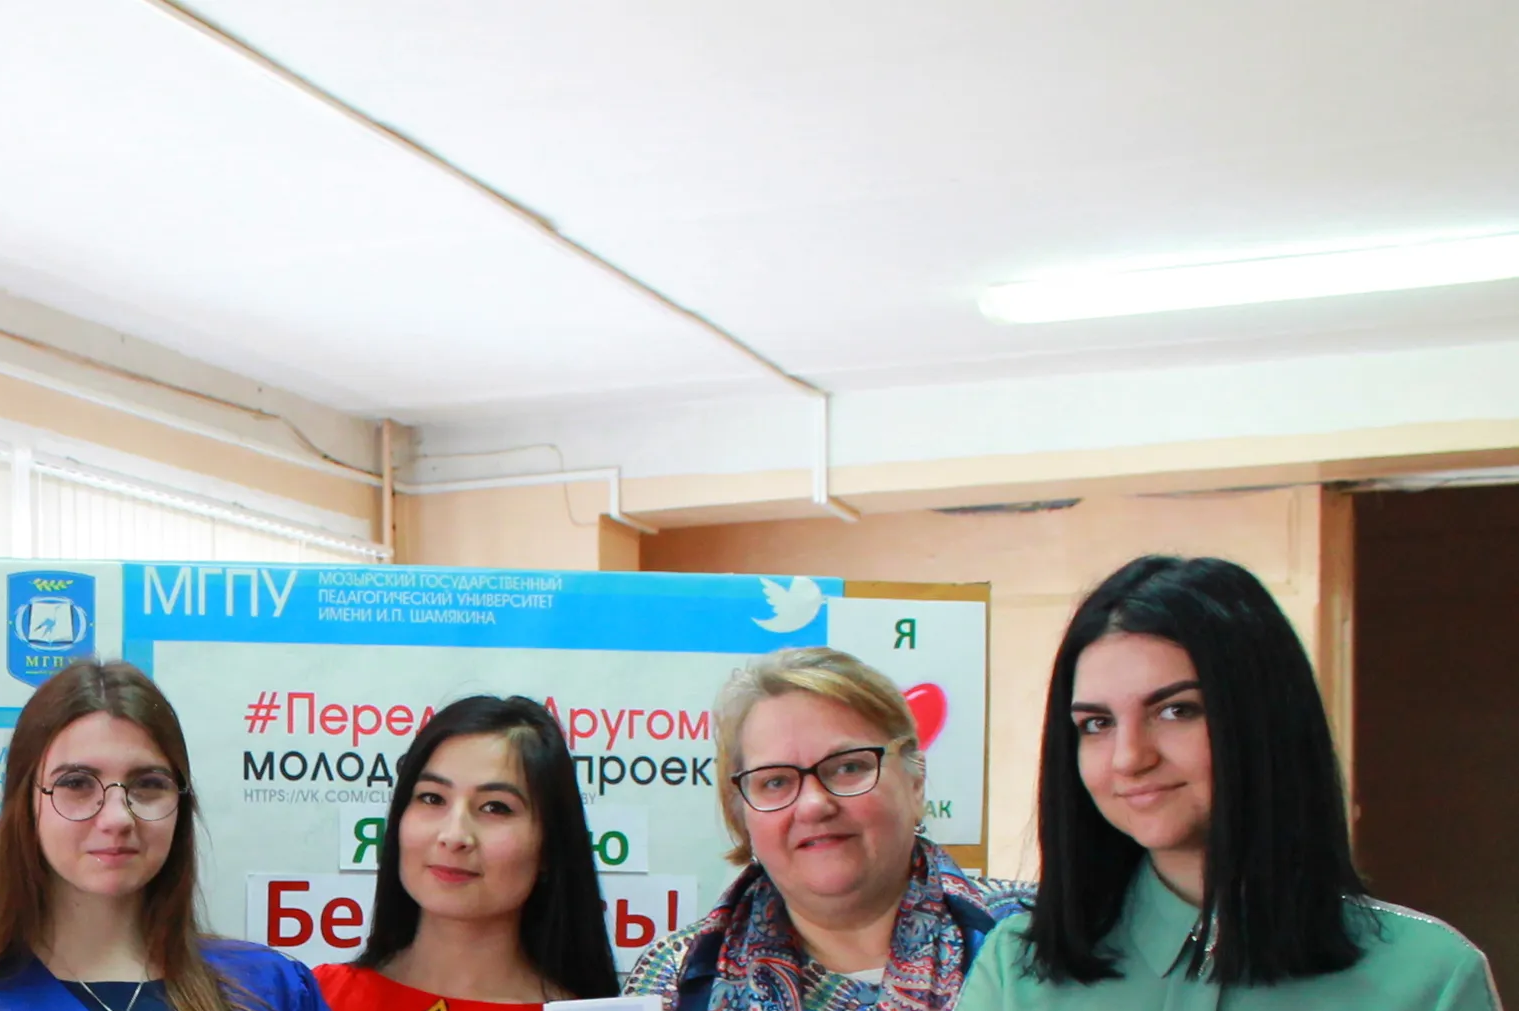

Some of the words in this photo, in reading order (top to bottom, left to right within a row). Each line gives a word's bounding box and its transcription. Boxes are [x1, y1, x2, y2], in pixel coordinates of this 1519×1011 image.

[144, 565, 299, 618] МГПУ
[318, 571, 416, 588] МОЗЫРСКИЙ
[419, 573, 563, 592] ГОСУДАРСТВЕННЫЙ
[318, 588, 453, 607] ПЕДАГОГИЧЕСКИЙ
[458, 593, 554, 609] УНИВЕРСИТЕТ
[318, 607, 373, 622] ИМЕНИ
[410, 608, 497, 625] ШАМЯКИНА
[893, 618, 916, 650] Я
[352, 817, 386, 864] Я
